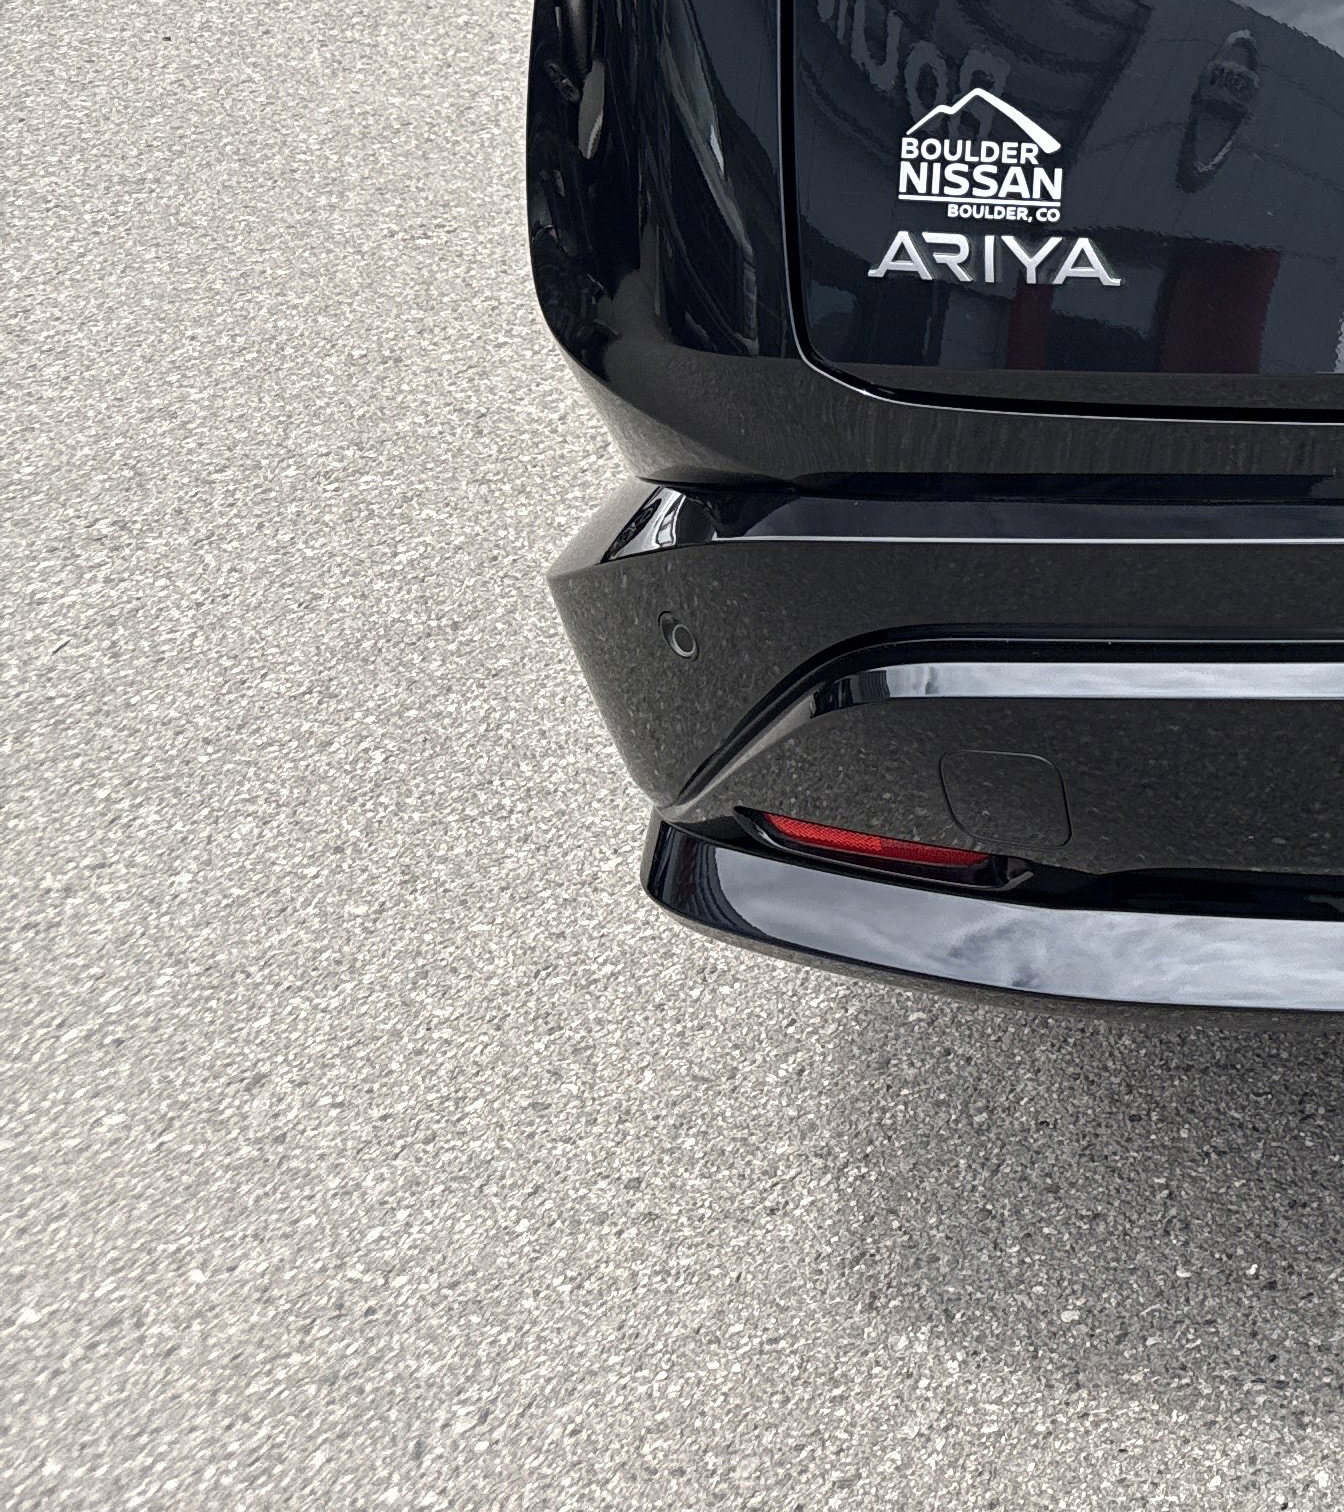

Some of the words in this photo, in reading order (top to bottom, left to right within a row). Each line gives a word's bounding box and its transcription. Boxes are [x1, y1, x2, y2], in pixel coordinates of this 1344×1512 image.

[900, 137, 1039, 165] BOULDER
[898, 160, 1063, 200] NISSAN
[947, 203, 1033, 223] BOULDER,
[1035, 207, 1061, 223] CO
[867, 230, 1122, 287] ARIYA
